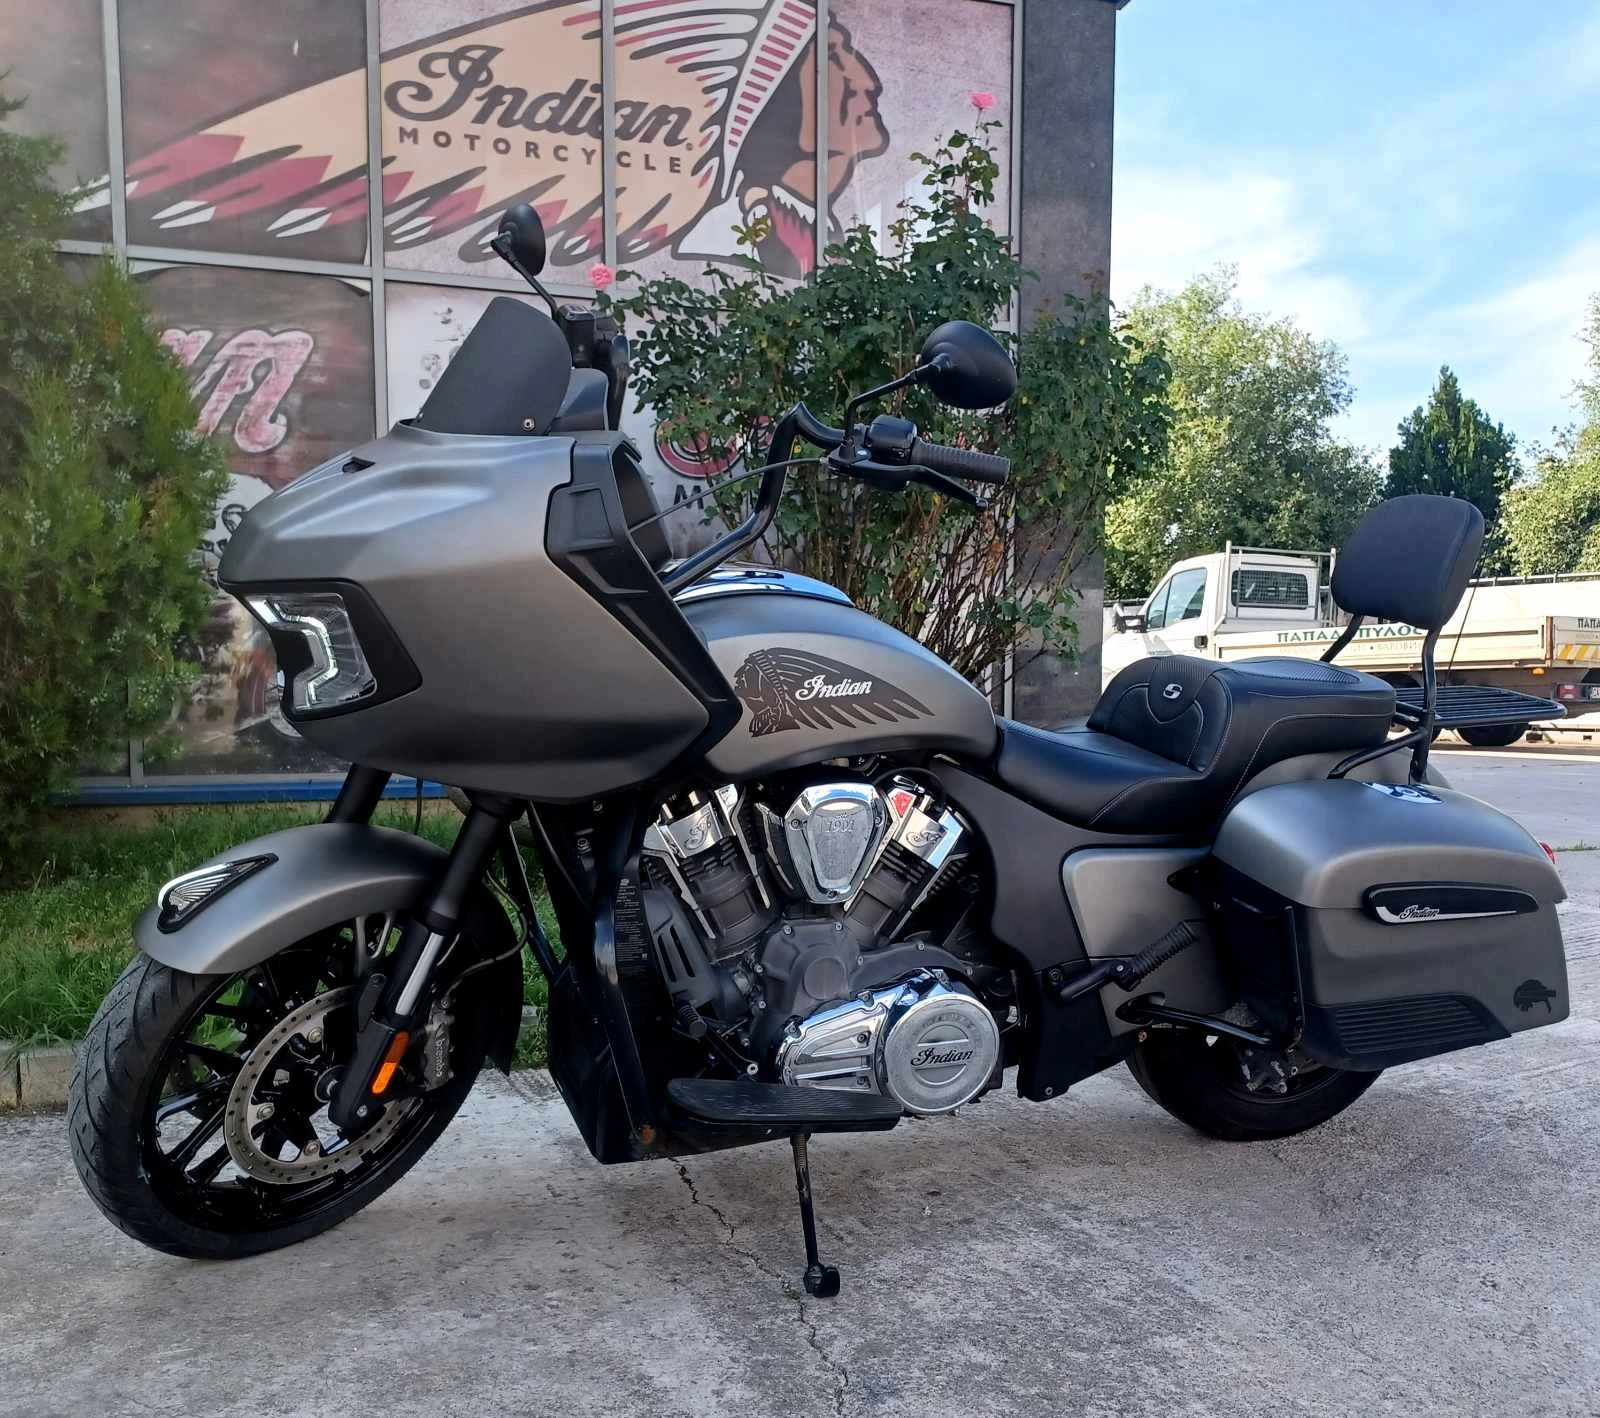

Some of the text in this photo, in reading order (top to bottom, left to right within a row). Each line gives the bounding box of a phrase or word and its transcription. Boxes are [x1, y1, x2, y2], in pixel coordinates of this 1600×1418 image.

[383, 44, 692, 147] Indian
[399, 126, 681, 174] MOTORCYCLE
[795, 675, 872, 701] Indian
[1400, 905, 1440, 920] Indian
[911, 1047, 974, 1066] Indian
